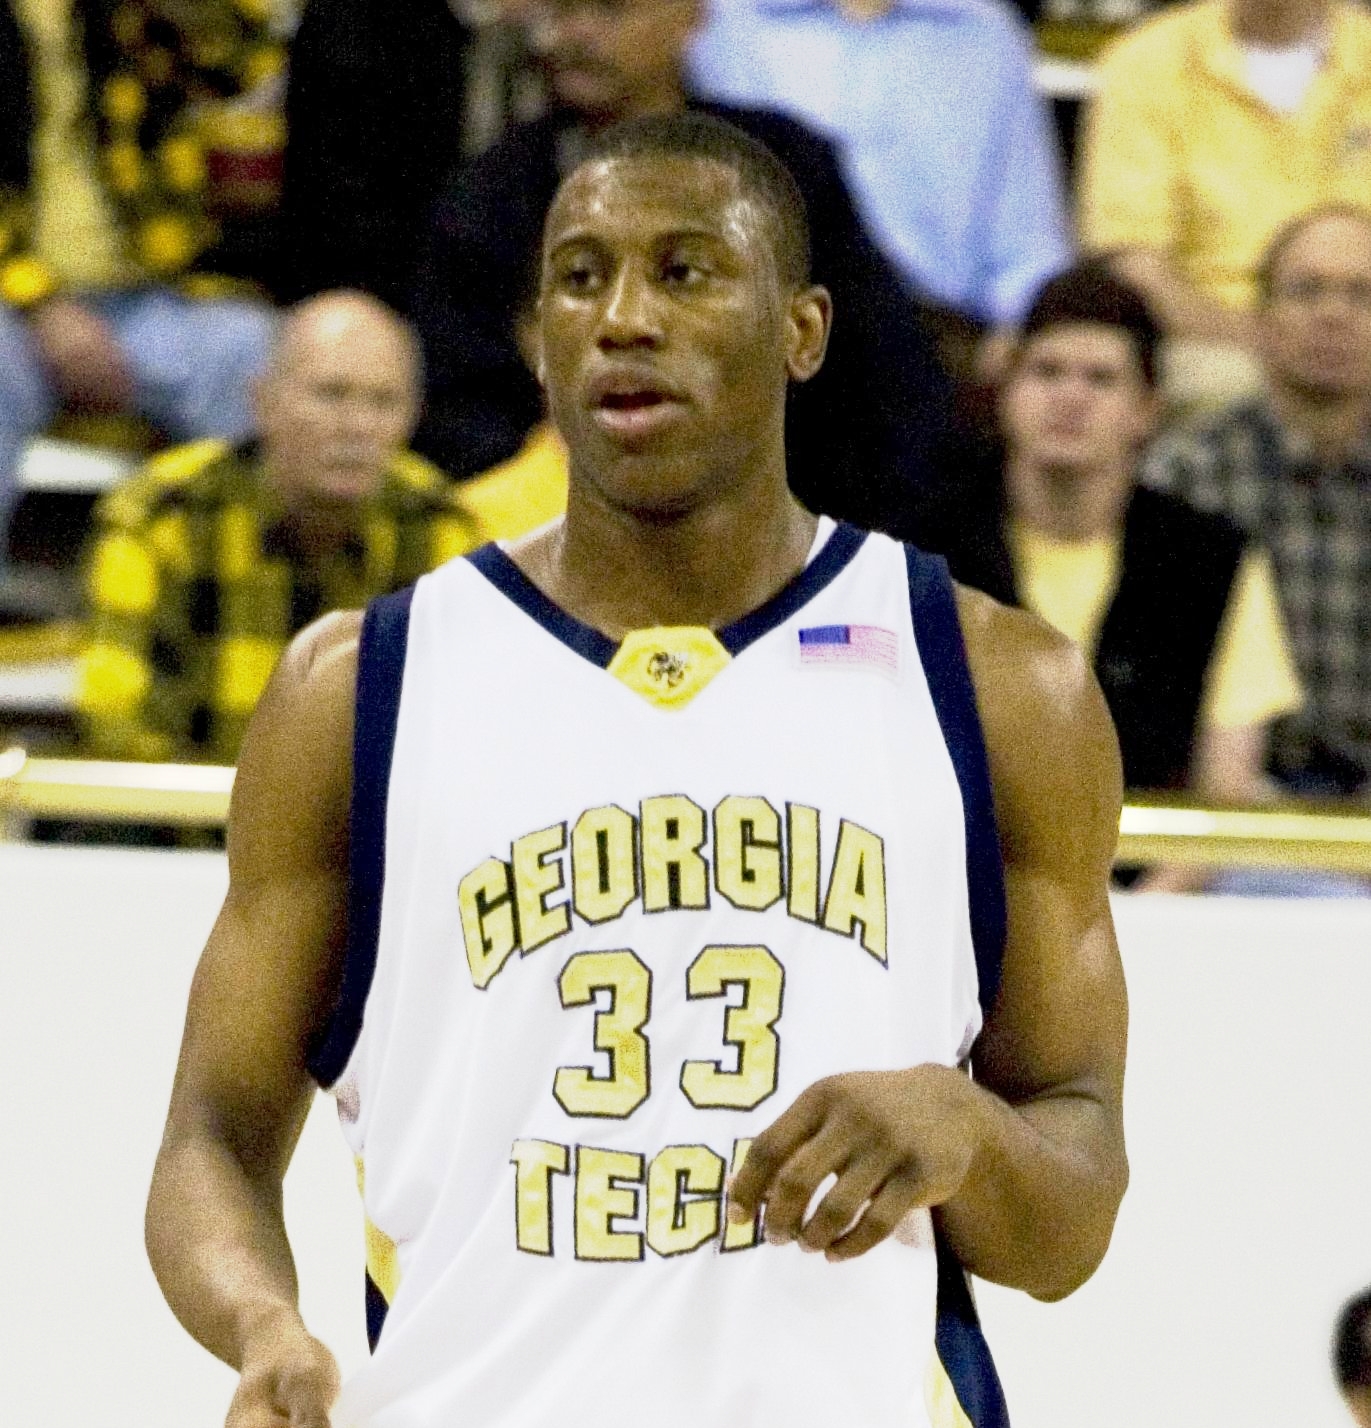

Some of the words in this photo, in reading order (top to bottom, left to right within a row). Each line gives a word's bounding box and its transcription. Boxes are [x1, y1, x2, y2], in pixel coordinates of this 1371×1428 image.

[457, 793, 889, 991] GEORGIA
[552, 943, 786, 1120] 33
[508, 1137, 766, 1263] TEC
